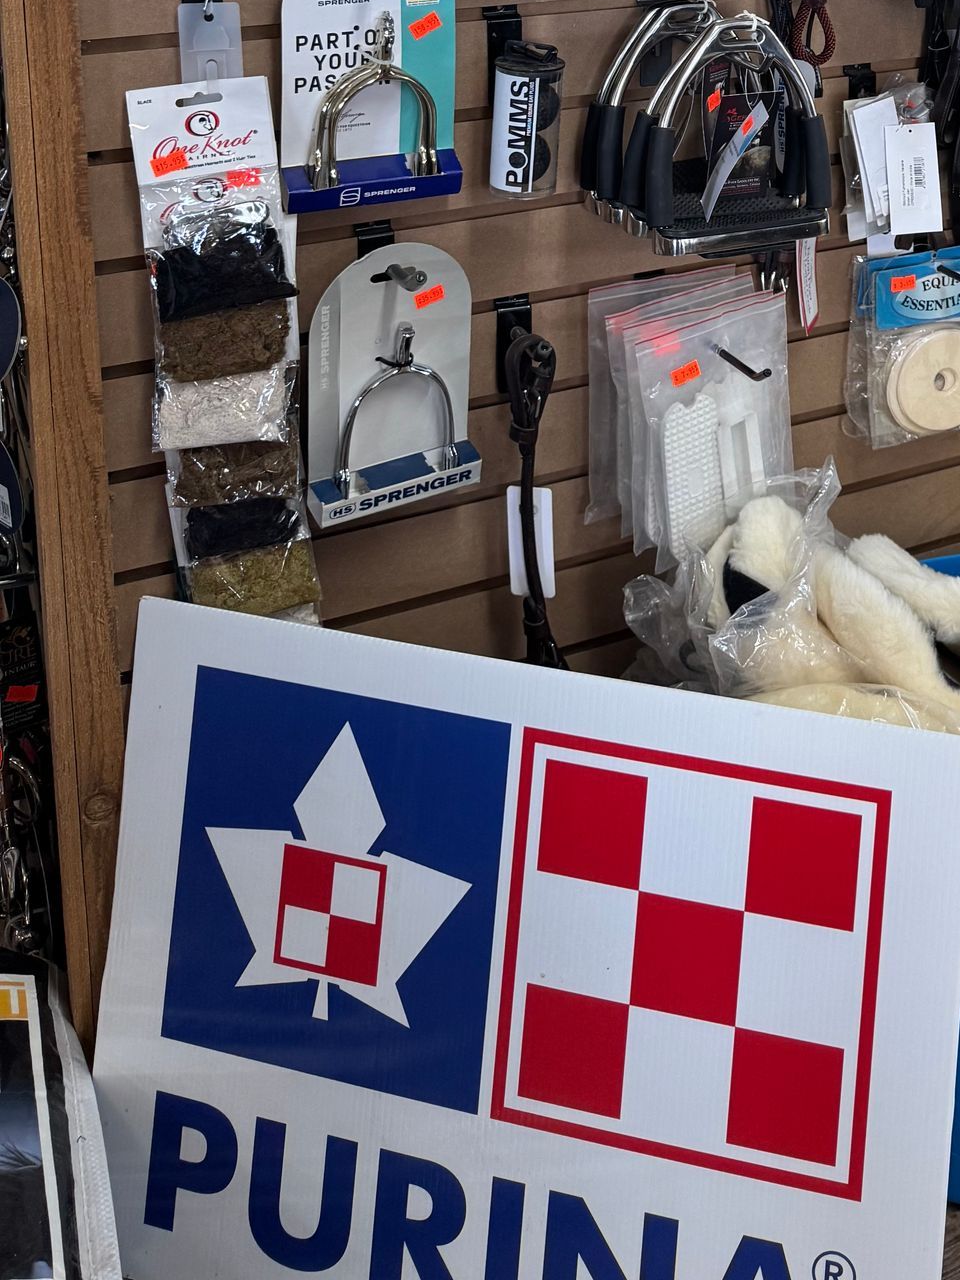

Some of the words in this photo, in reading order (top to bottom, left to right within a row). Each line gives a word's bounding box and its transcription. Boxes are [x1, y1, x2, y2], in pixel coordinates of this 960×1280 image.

[295, 31, 354, 52] PART
[364, 29, 379, 46] O
[153, 137, 200, 157] One
[201, 129, 253, 156] Knot
[505, 80, 530, 192] POMMS
[364, 186, 416, 198] SPRENGER
[315, 304, 334, 374] SPRENGER
[332, 505, 354, 518] HS
[358, 469, 473, 513] SPRENGER
